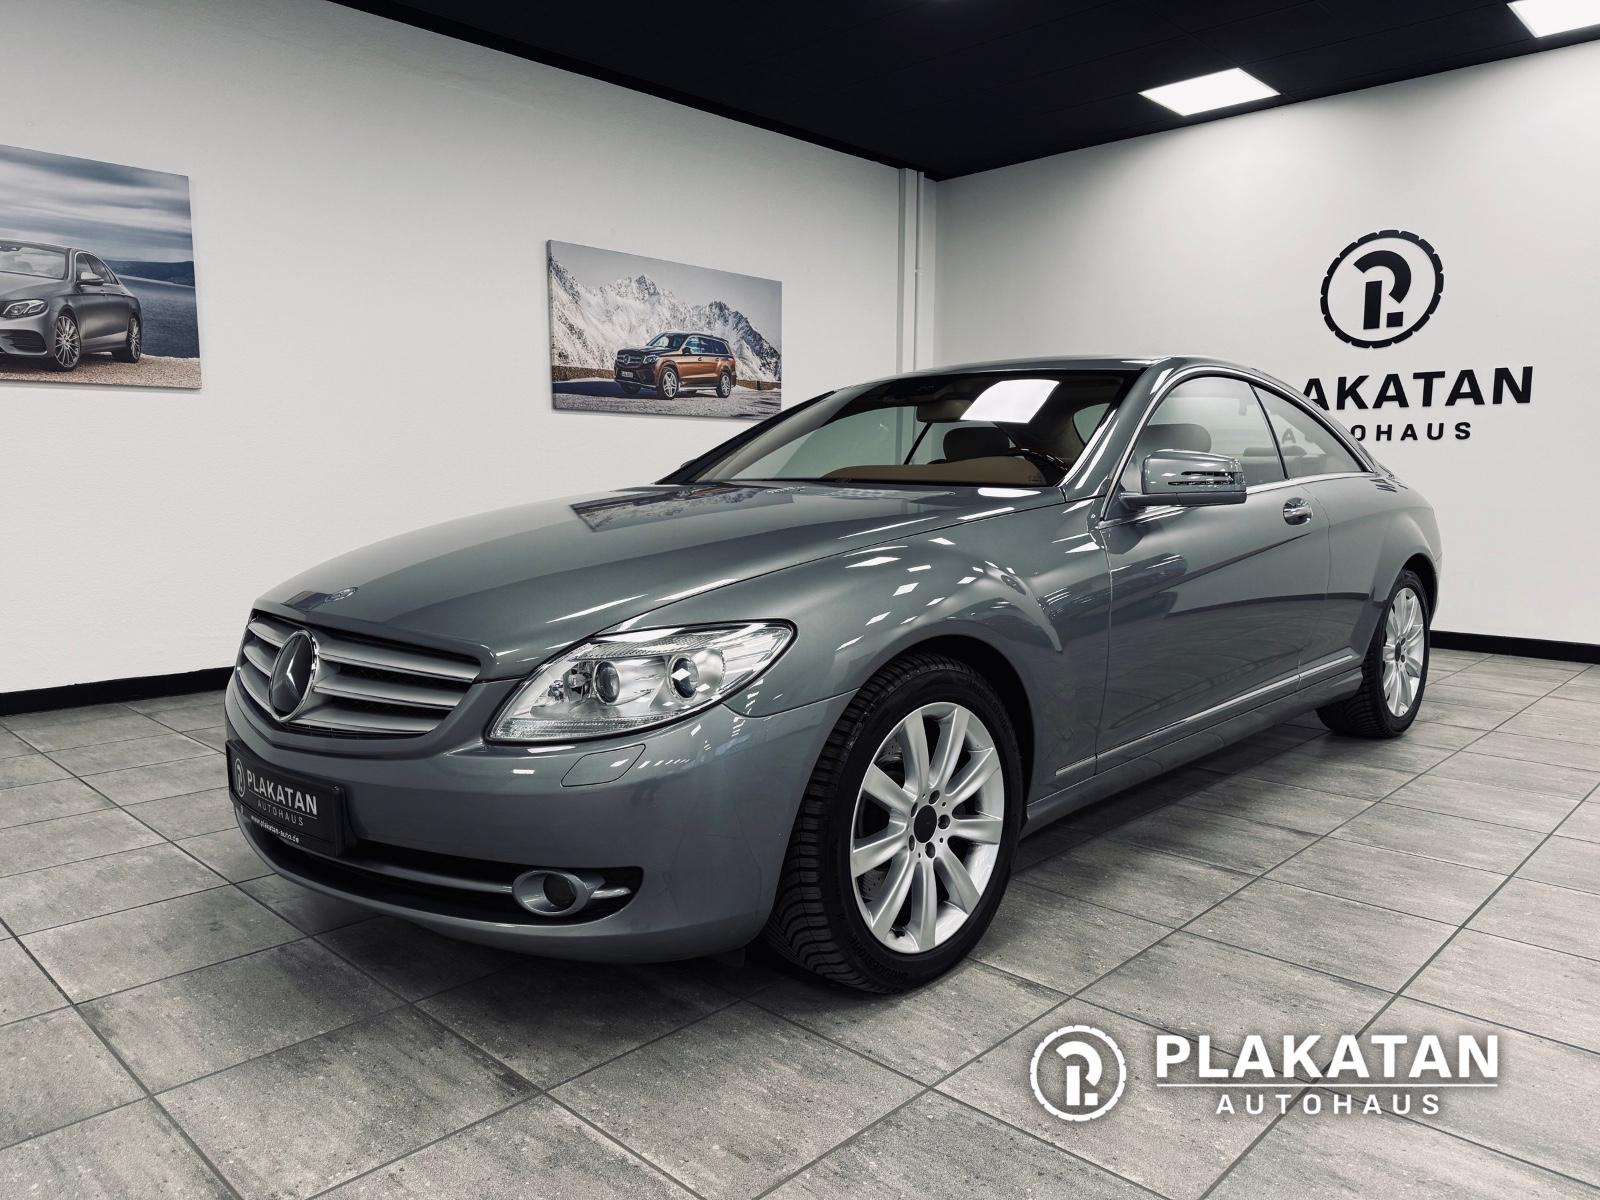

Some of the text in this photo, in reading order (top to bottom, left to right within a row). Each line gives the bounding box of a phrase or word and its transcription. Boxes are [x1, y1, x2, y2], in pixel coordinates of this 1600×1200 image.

[1303, 366, 1534, 411] AKATAN
[246, 769, 318, 816] PLAKATAN
[257, 799, 304, 827] AUTOHAUS
